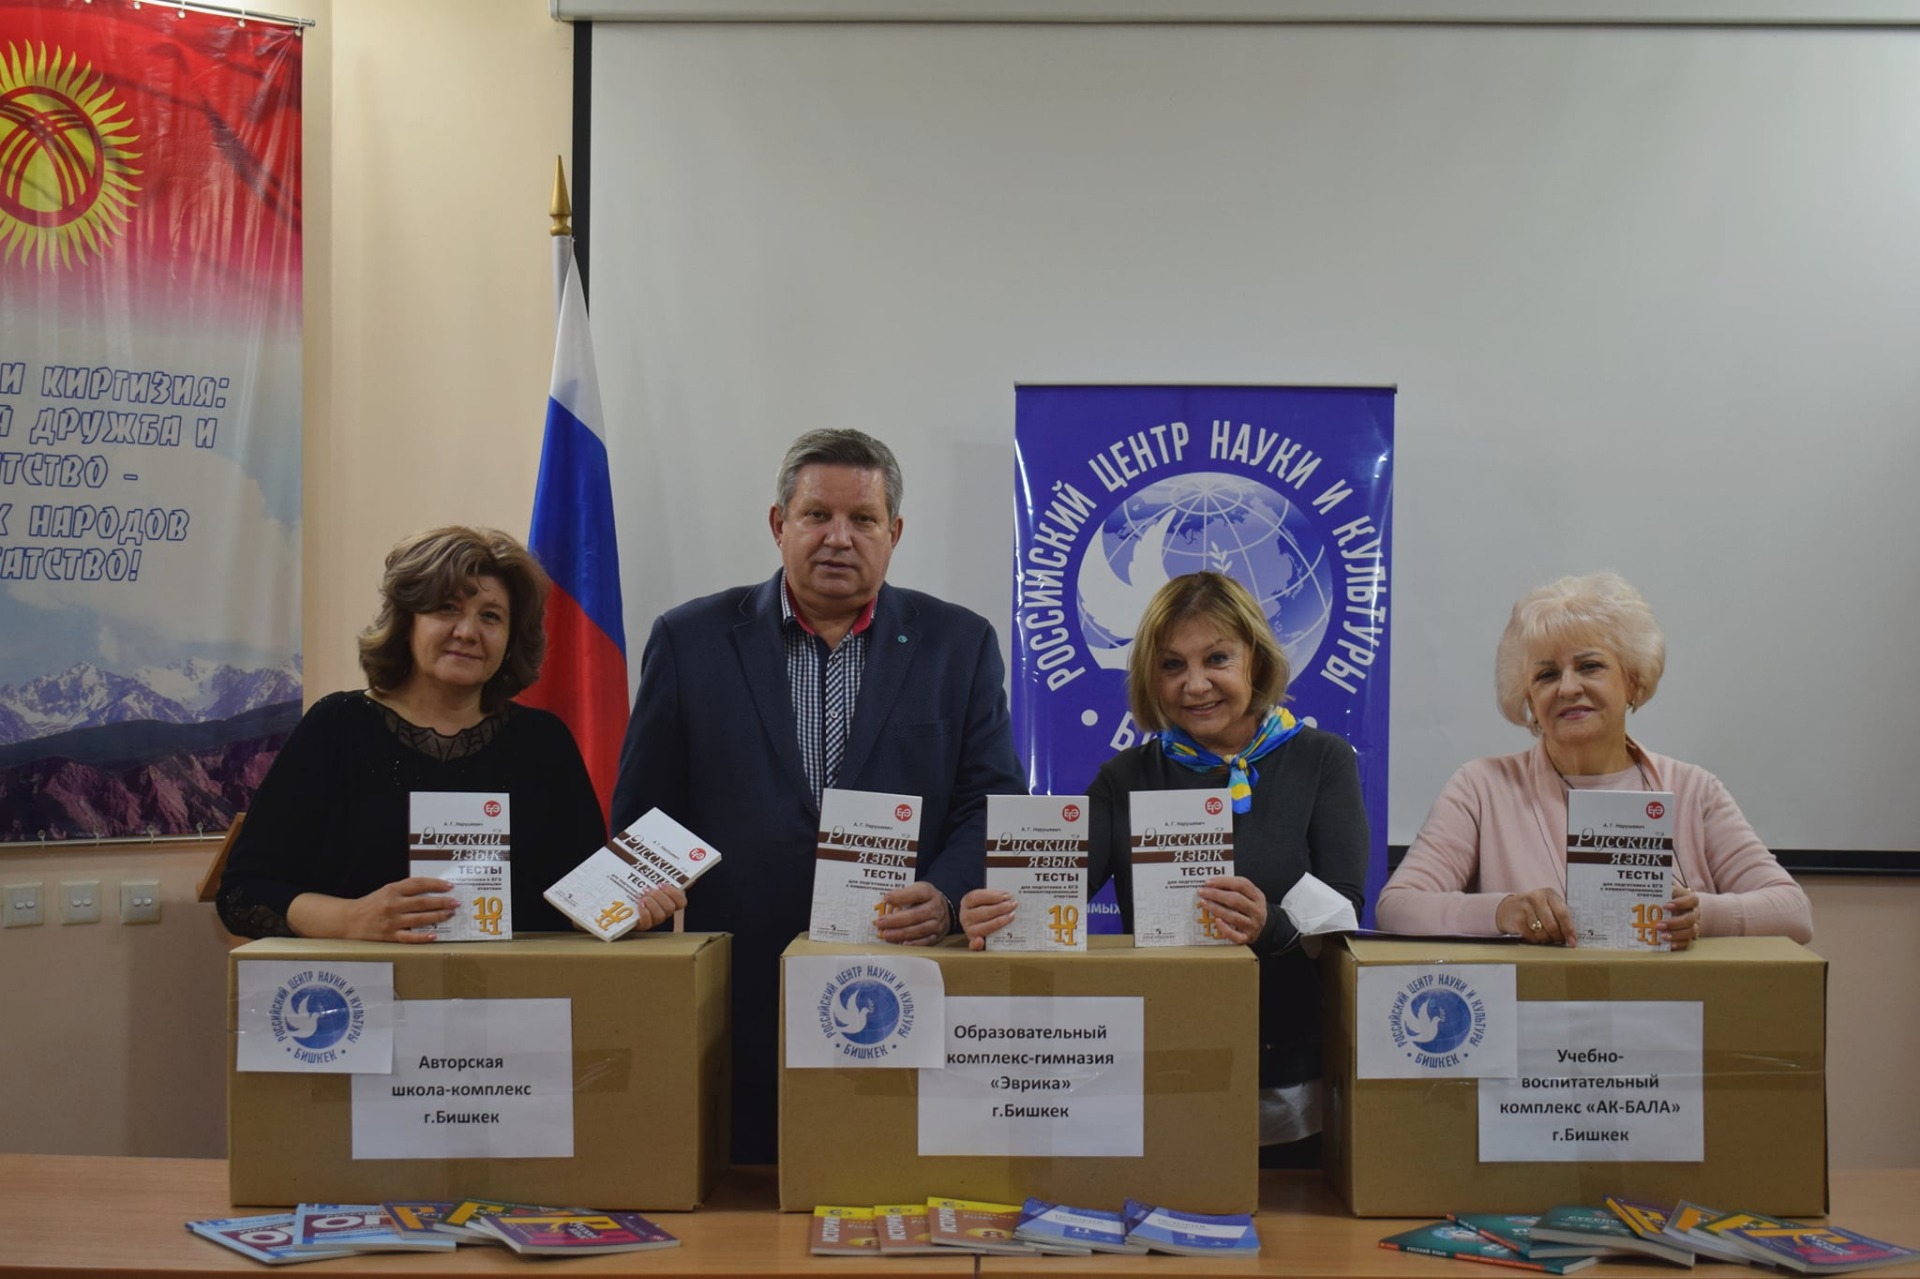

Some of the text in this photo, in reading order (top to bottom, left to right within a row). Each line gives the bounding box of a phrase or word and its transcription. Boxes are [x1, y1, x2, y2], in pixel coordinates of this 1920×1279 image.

[41, 366, 229, 408] КИРГИЗИЯ:
[29, 408, 182, 446] ДРУЖБА
[195, 418, 217, 448] И
[0, 452, 108, 488] ТСТВО
[29, 505, 190, 545] НАРОДОВ
[0, 547, 142, 581] АТСТВО!
[1024, 420, 1387, 694] РОССИЙСКИЙ ЦЕНТР НАУКИ И КУЛЬТУРЫ
[418, 827, 502, 849] Русский
[826, 825, 911, 850] Русский
[994, 832, 1080, 855] Русский
[1139, 827, 1224, 850] Русский
[1575, 828, 1664, 851] Русский
[451, 849, 500, 861] язык
[624, 835, 688, 880] Русский
[857, 851, 908, 867] язык
[1027, 856, 1079, 868] язык
[1173, 849, 1224, 863] язык
[1610, 852, 1664, 866] язык
[458, 865, 502, 875] ТЕСТЫ
[863, 868, 906, 881] ТЕСТЫ
[1035, 873, 1079, 882] ТЕСТЫ
[1180, 866, 1225, 876] ТЕСТЫ
[1617, 870, 1664, 880] ТЕСТЫ
[472, 896, 503, 919] 10
[602, 901, 635, 924] 10
[1631, 904, 1664, 928] 10
[1047, 904, 1079, 929] 10
[1054, 926, 1077, 946] 11
[270, 971, 364, 1044] РОССИЙСКИЙ ЦЕНТР НАУКИ И КУЛЬТУРЫ
[817, 965, 915, 1039] РОССИЙСКИЙ ЦЕНТР НАУКИ И КУЛЬТУРЫ
[1388, 974, 1486, 1048] РОССИЙСКИЙ ЦЕНТР НАУКИ И КУЛЬТУРЫ
[954, 1024, 1107, 1042] Образовательный
[293, 1048, 337, 1064] БИШКЕК
[843, 1044, 889, 1059] БИШКЕК
[946, 1052, 1114, 1067] комплекс-гимназия
[1557, 1049, 1624, 1065] Учебно-
[418, 1055, 504, 1070] Авторская
[1414, 1053, 1460, 1068] БИШКЕК
[391, 1083, 532, 1098] школа-комплекс
[990, 1076, 1071, 1093] «Эврика»
[1521, 1074, 1659, 1090] воспитательный
[992, 1104, 1069, 1119] г.Бишкек
[1500, 1099, 1681, 1117] комплекс «АК-БАЛА»
[424, 1110, 500, 1125] г.Бишкек
[1552, 1128, 1629, 1142] г.Бишкек
